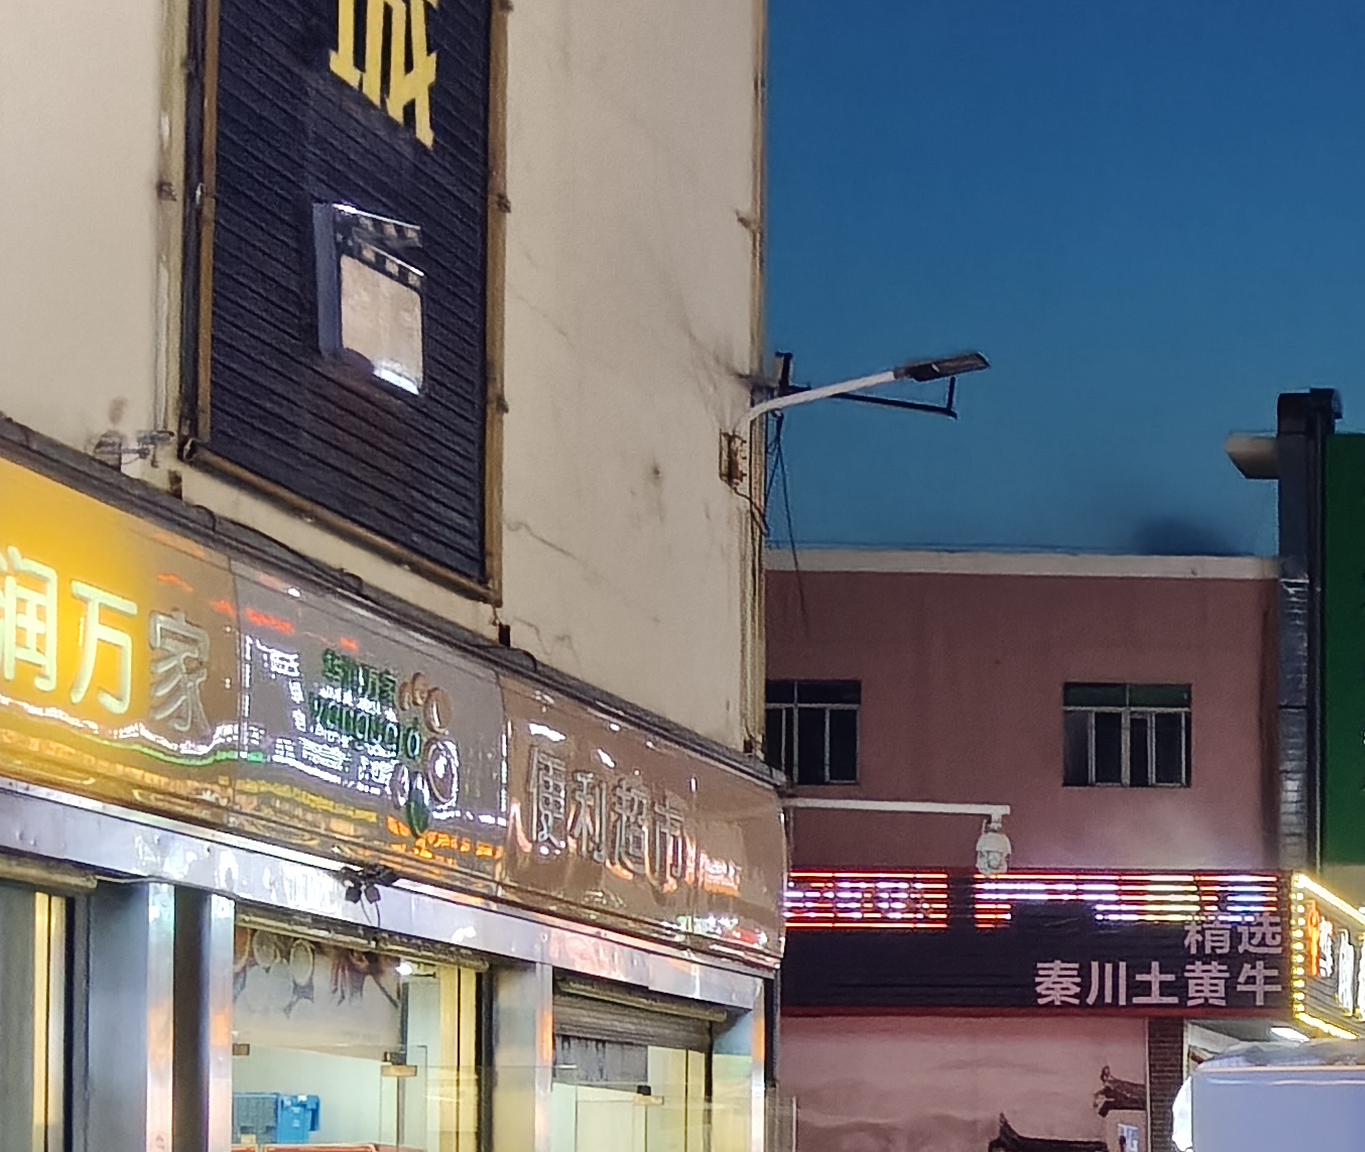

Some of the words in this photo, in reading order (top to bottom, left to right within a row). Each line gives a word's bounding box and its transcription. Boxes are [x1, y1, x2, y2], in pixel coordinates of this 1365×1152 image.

[528, 745, 685, 885] 便利超市
[1184, 913, 1283, 955] 精选
[1034, 960, 1283, 1007] 秦川土黄牛
